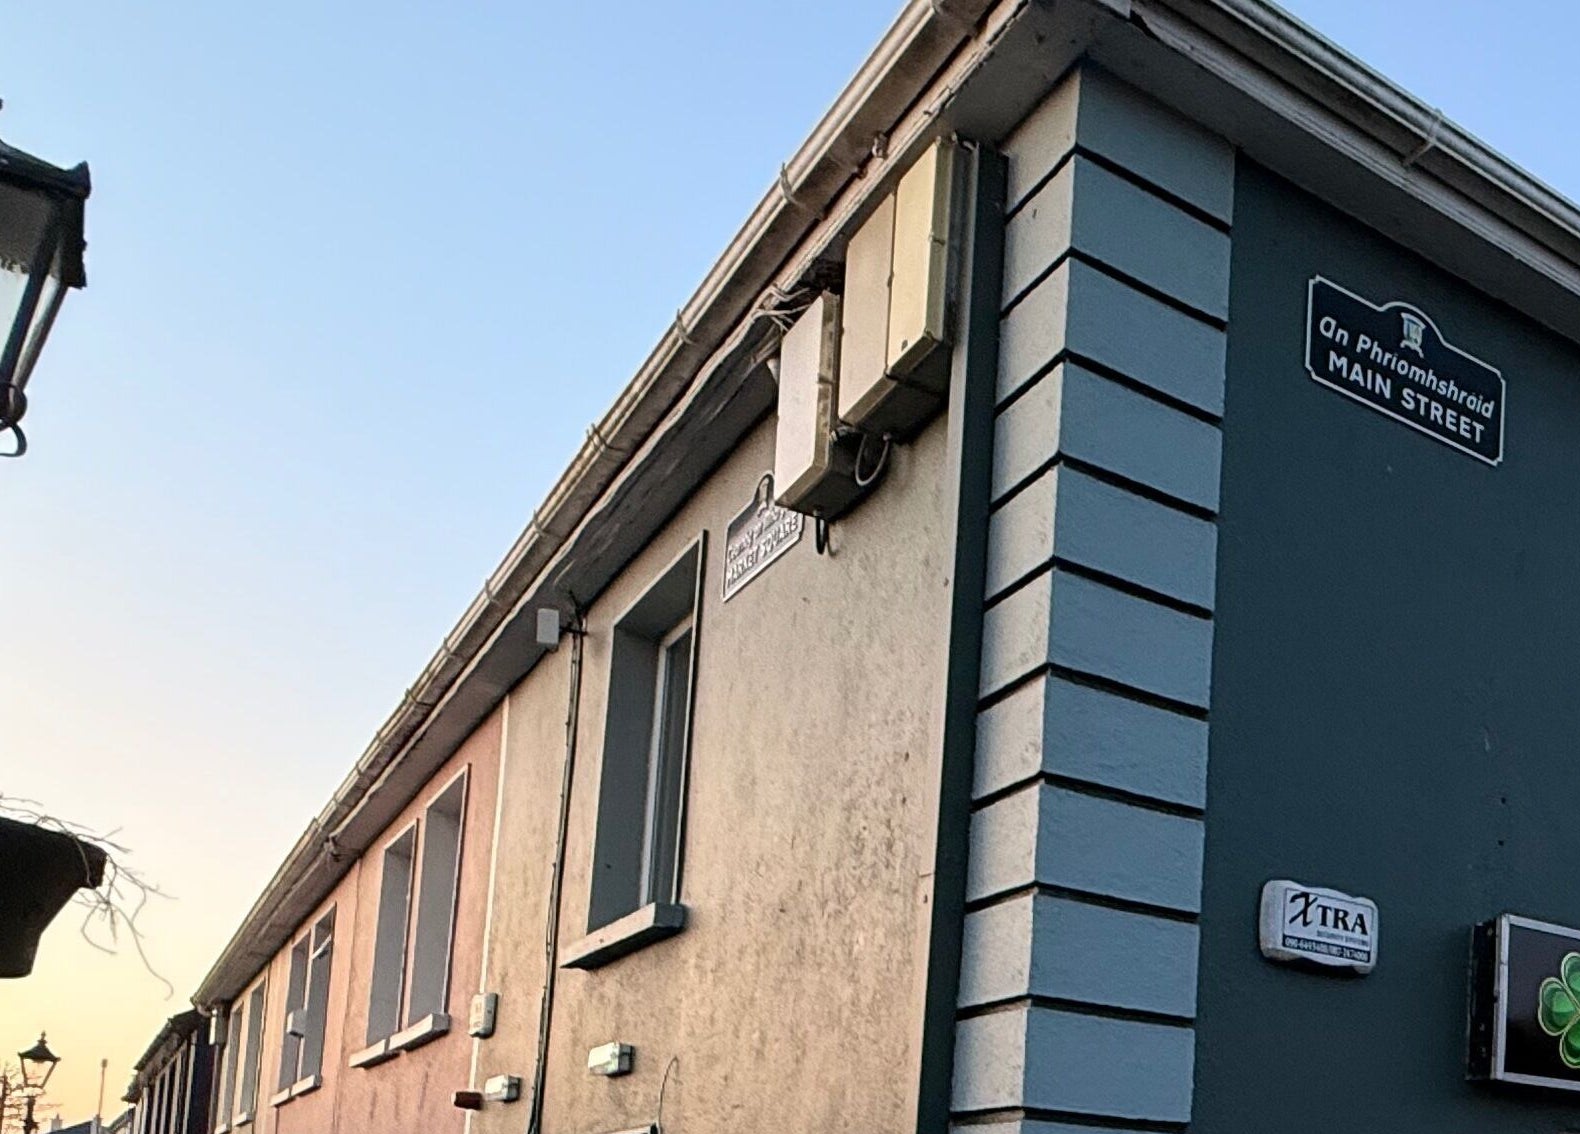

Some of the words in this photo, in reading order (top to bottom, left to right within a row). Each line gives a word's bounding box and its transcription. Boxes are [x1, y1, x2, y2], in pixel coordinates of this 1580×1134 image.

[1328, 350, 1391, 400] MAIN
[1400, 387, 1485, 444] STREET
[1288, 891, 1369, 936] XTRA
